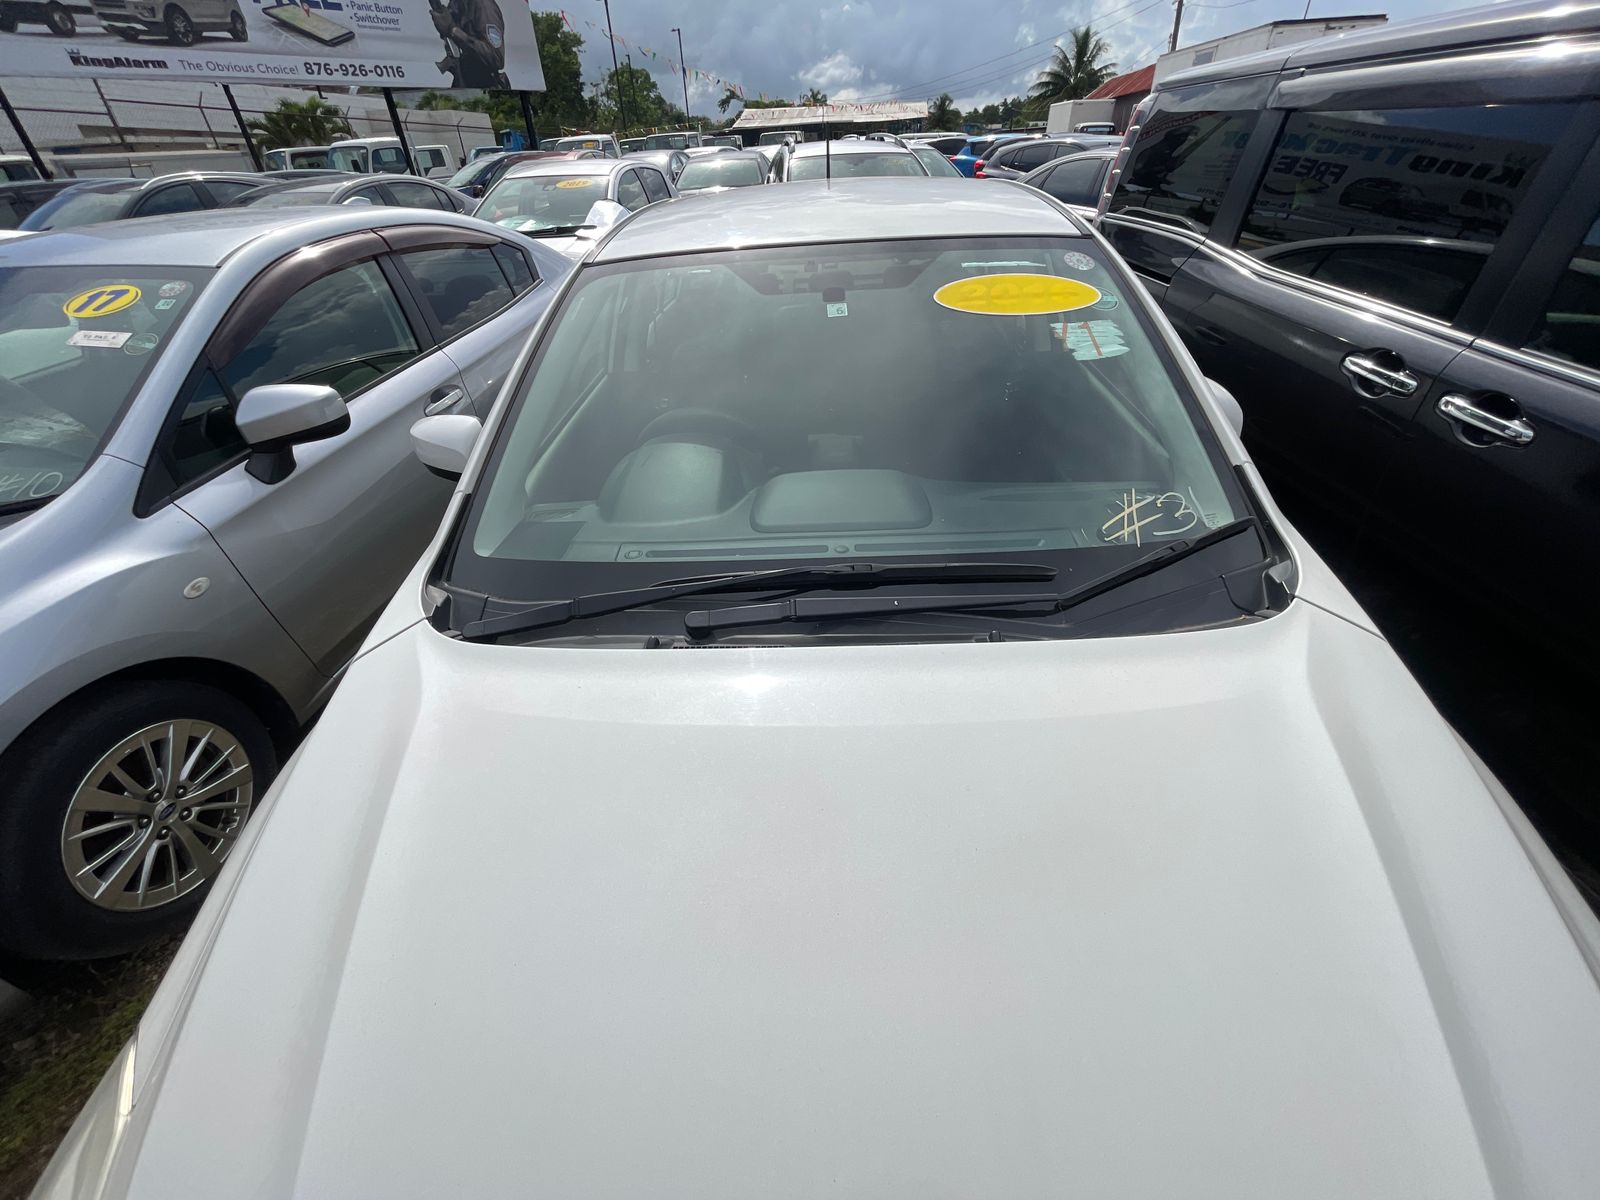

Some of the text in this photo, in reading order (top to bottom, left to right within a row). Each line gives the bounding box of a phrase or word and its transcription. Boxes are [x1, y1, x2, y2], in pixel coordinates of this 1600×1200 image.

[350, 1, 374, 12] Panic
[374, 3, 403, 15] Button
[354, 13, 400, 25] Switchover
[70, 55, 169, 69] KingAlarm
[178, 59, 299, 75] The Obvious Choice!
[303, 61, 405, 79] 876-926-0116
[73, 289, 130, 313] 17
